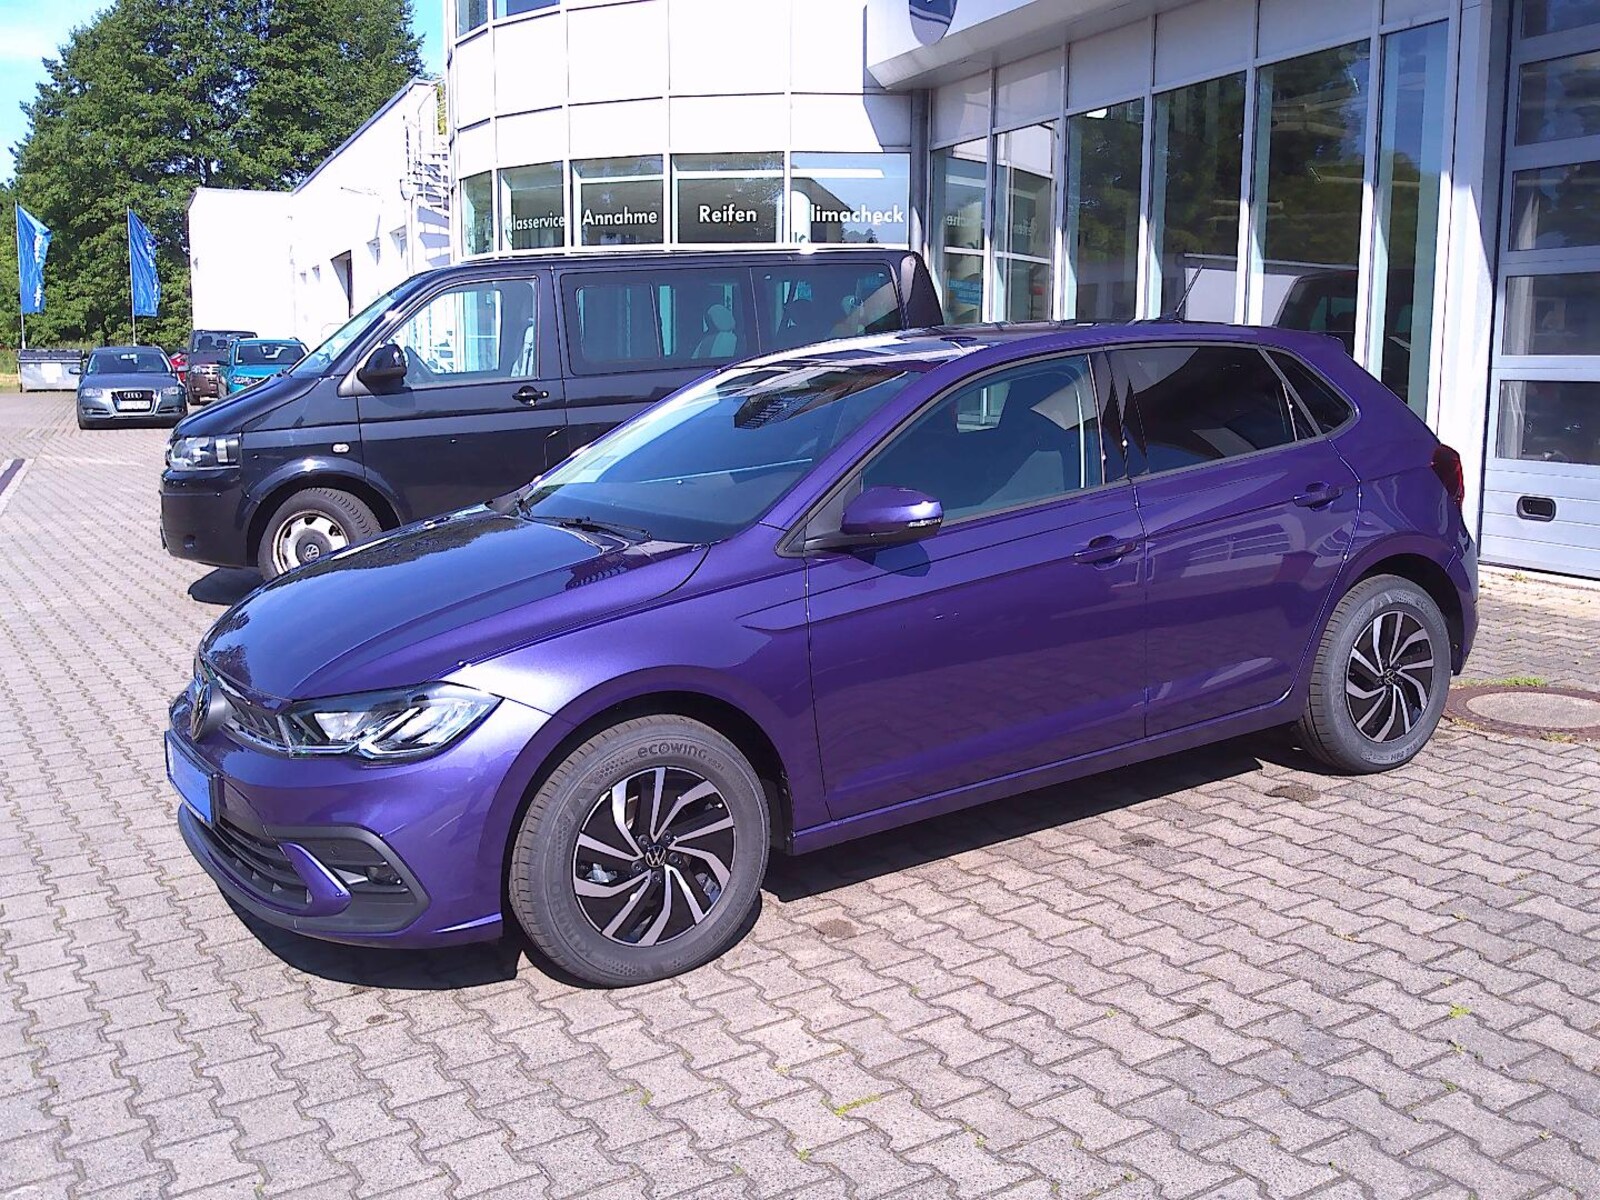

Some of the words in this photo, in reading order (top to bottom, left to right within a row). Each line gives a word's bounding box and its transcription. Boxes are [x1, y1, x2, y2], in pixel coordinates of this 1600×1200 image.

[582, 206, 658, 226] Annahme
[699, 204, 757, 223] Reifen
[809, 203, 904, 224] limacheck
